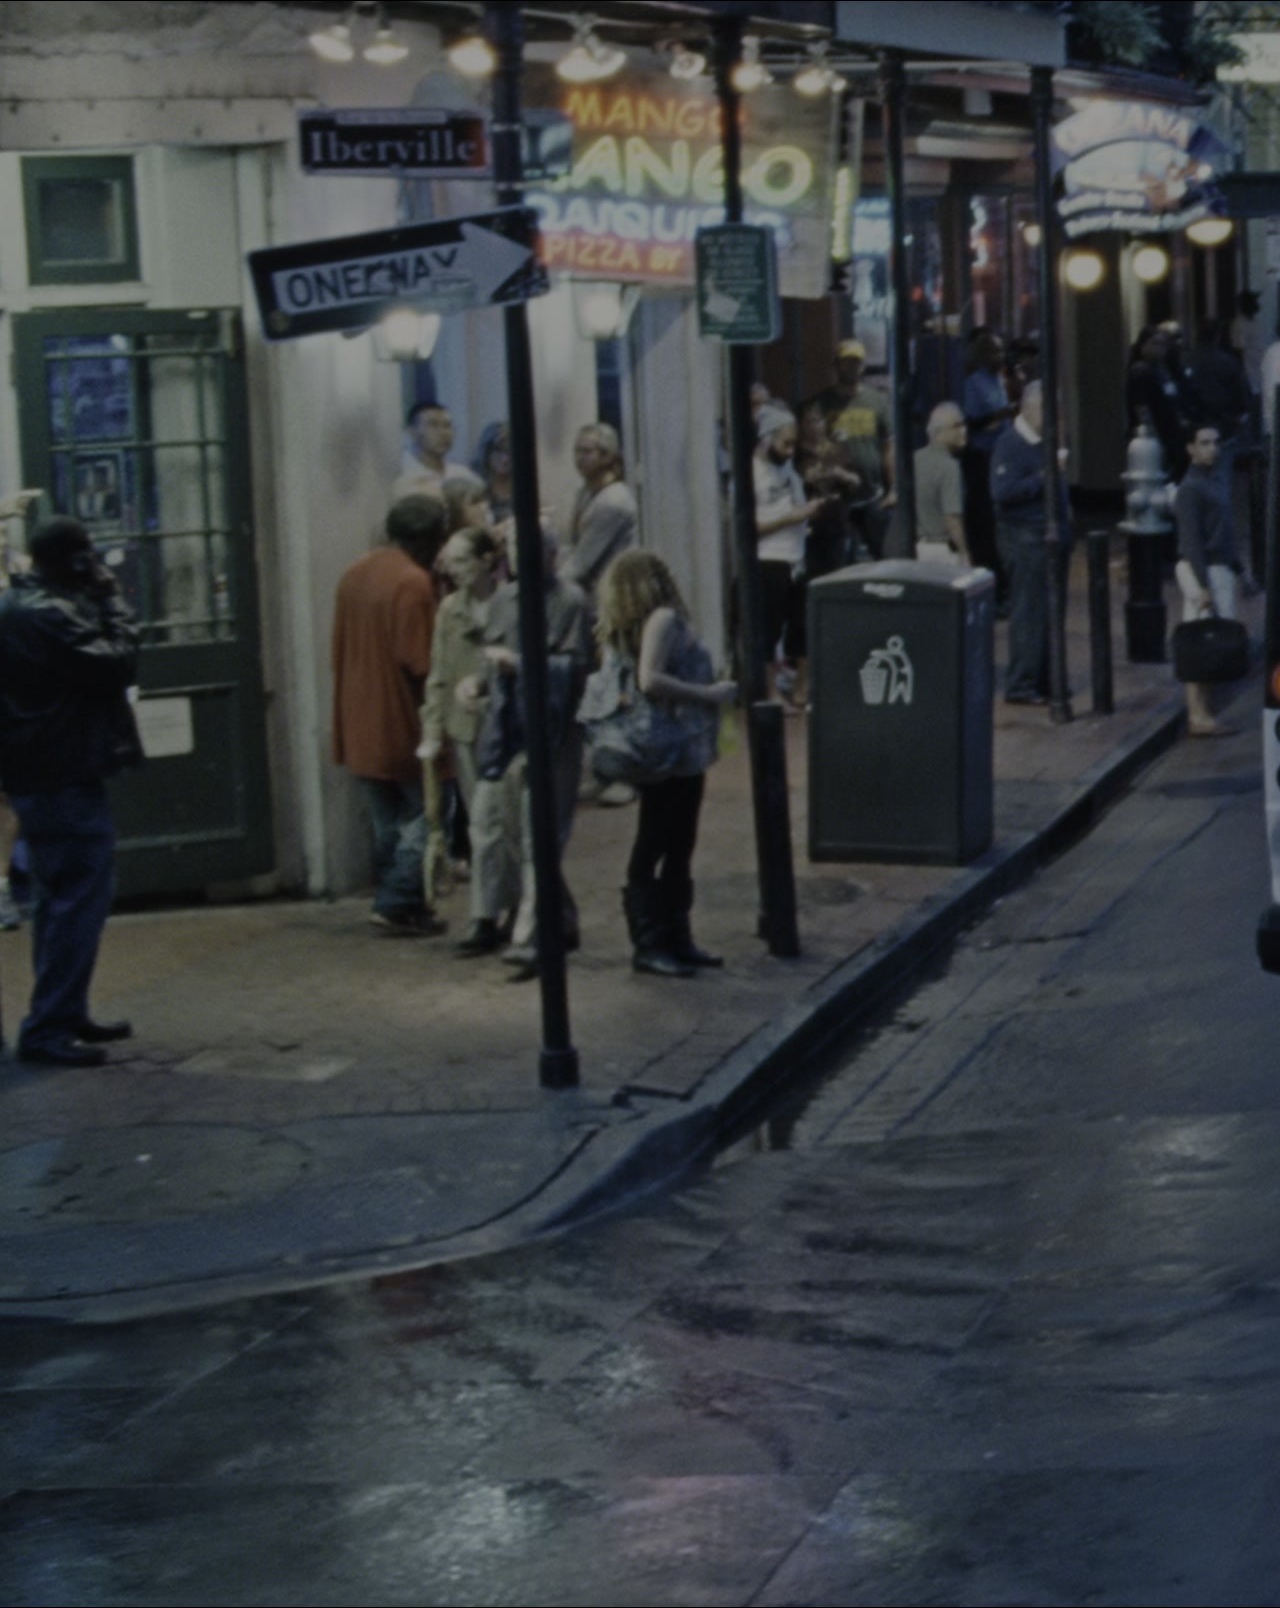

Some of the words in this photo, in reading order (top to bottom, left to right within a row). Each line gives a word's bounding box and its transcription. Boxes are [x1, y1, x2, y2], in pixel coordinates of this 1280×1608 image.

[309, 129, 477, 162] Iberville
[553, 134, 813, 206] ANGO
[543, 234, 640, 270] PIZZA
[286, 263, 363, 307] ONE
